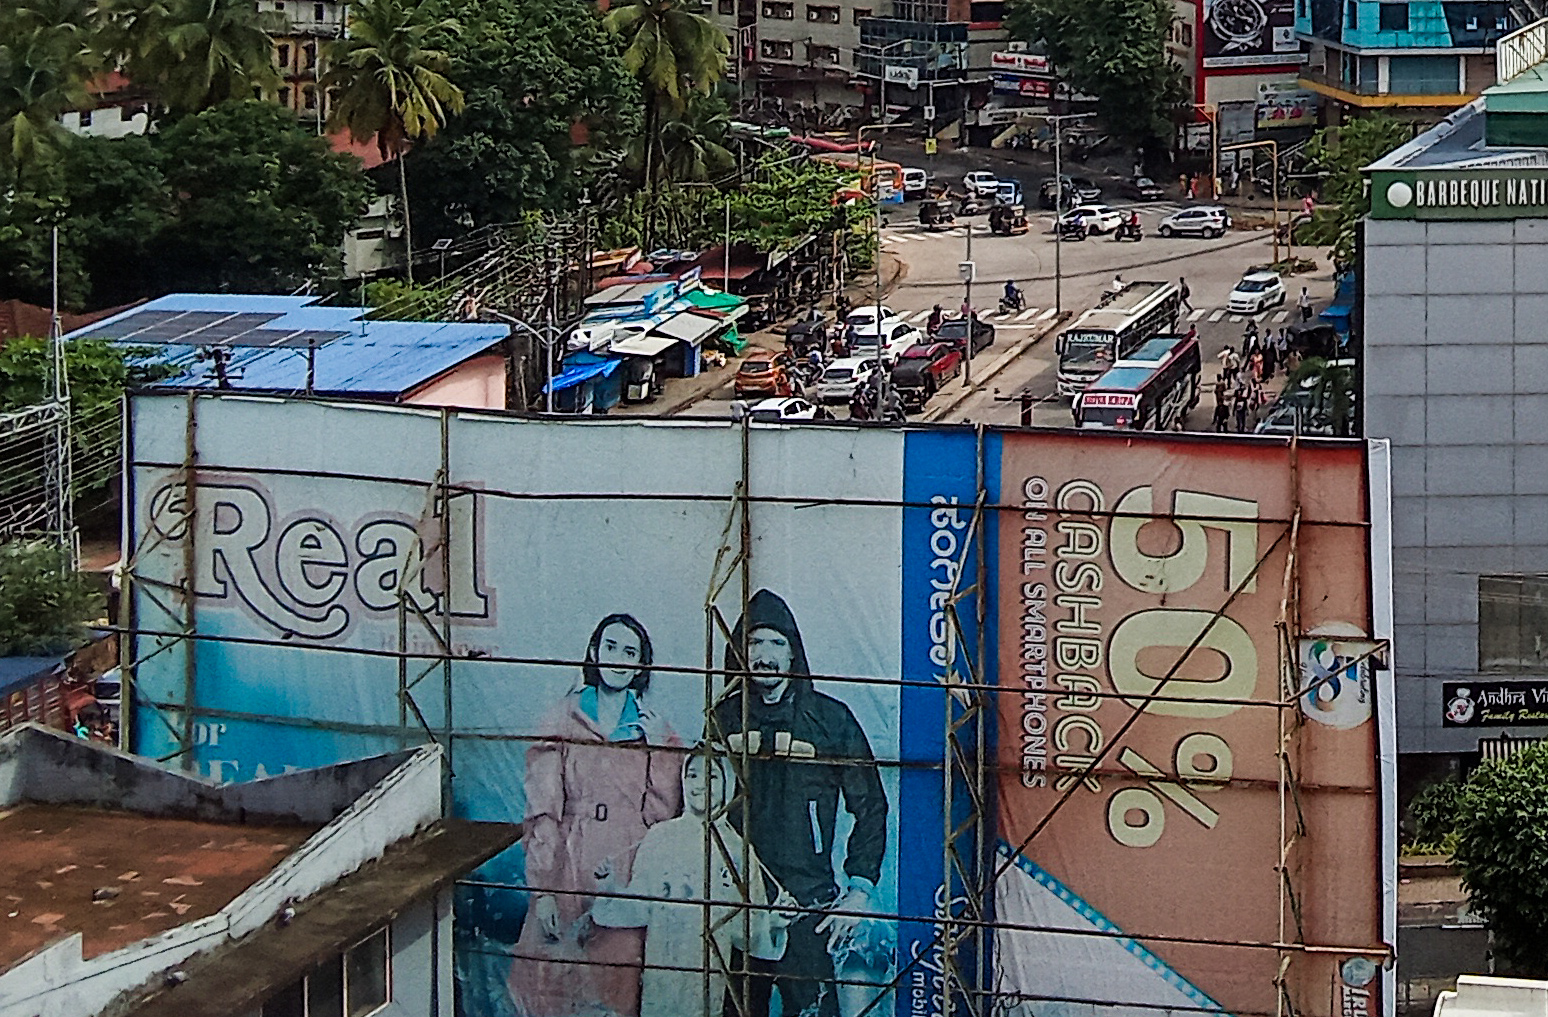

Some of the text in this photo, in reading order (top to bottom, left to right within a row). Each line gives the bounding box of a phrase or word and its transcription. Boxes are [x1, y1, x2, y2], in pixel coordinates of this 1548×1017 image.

[1416, 180, 1500, 208] BARBEQUE
[150, 483, 488, 640] Real
[1021, 476, 1049, 790] ON ALL SMARTPHONES
[1055, 478, 1106, 794] CASHBACK
[1106, 484, 1259, 849] 50%
[1477, 687, 1526, 707] Andhra
[1481, 709, 1515, 722] Family
